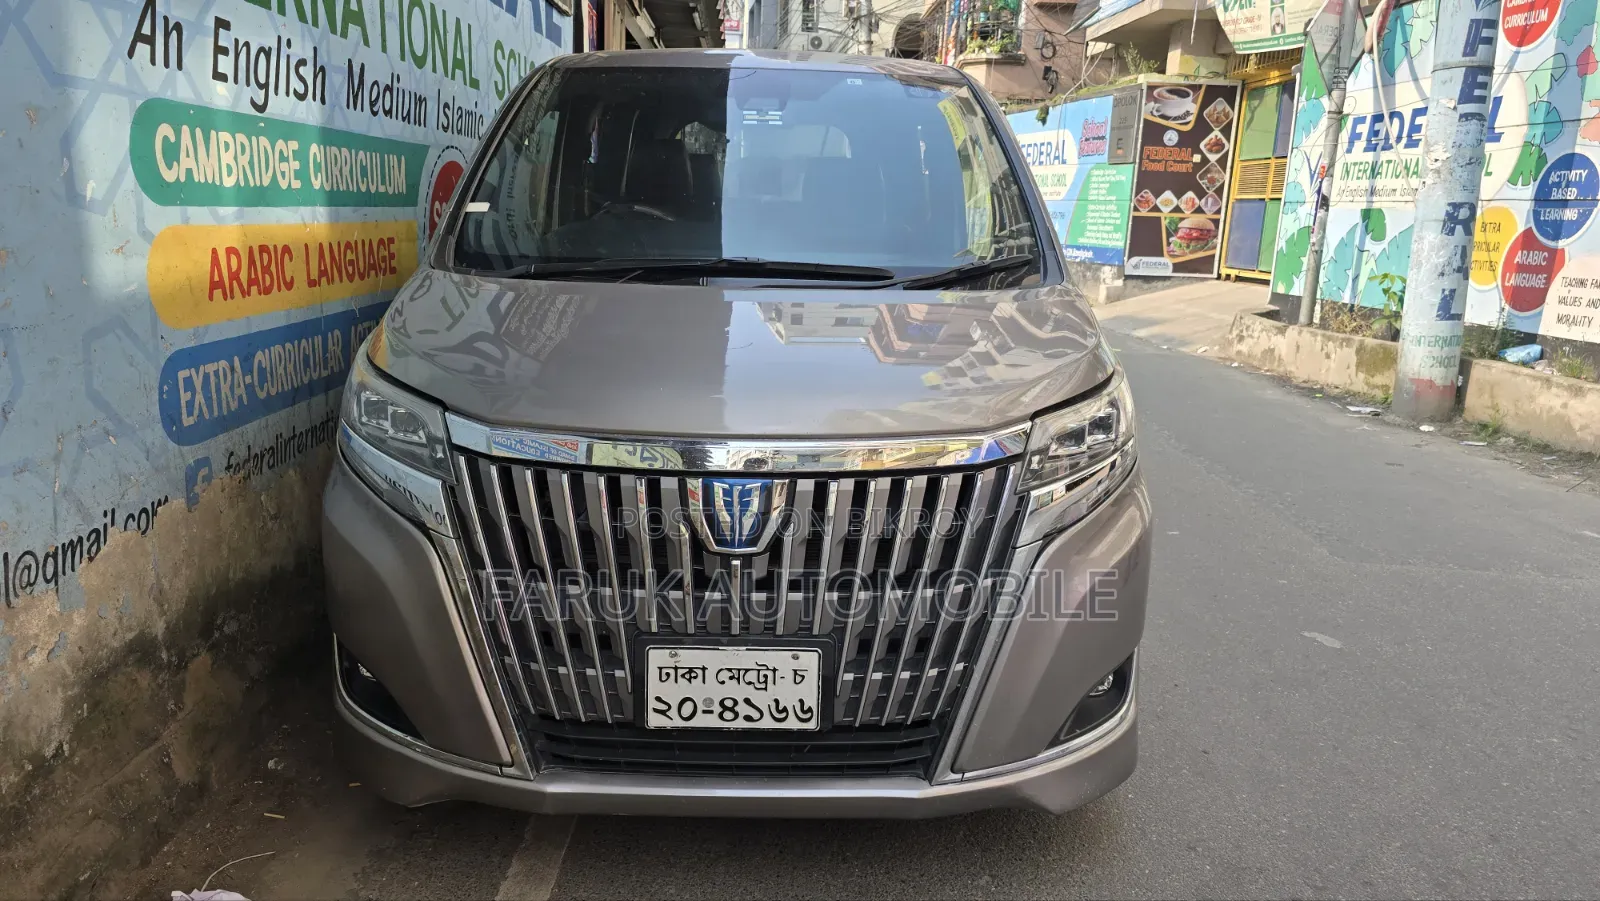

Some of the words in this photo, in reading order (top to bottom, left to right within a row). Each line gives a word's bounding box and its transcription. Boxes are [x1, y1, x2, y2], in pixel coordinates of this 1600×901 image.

[1504, 8, 1549, 29] CURRICULUM
[128, 0, 184, 71] An
[212, 17, 327, 114] English
[346, 58, 428, 129] Medium
[436, 89, 485, 141] Islamic
[154, 122, 301, 190] CAMBRIDGE
[309, 145, 407, 196] CURRICULUM
[1143, 146, 1193, 161] FEDERAL
[1142, 160, 1165, 171] Food
[1166, 160, 1193, 172] Court
[1339, 157, 1421, 181] INTERNATIONA
[1549, 169, 1588, 184] ACTIVITY
[1370, 184, 1397, 198] Medium
[1540, 208, 1578, 221] LEARNING
[1480, 221, 1501, 233] EXTRA
[1469, 259, 1498, 272] CTIVITIES
[1513, 250, 1549, 266] ARABIC
[206, 243, 295, 303] ARABIC
[304, 236, 398, 292] LANGUAGE
[1504, 272, 1548, 288] LANGUAGE
[1560, 276, 1589, 289] TEACHING
[1558, 295, 1583, 308] VALUES
[1585, 298, 1600, 310] AND
[1556, 313, 1594, 329] MORALITY
[177, 328, 345, 427] EXTRA-CURRICULAR
[224, 410, 339, 484] federalinternati
[657, 665, 709, 685] ঢাকা
[791, 668, 809, 685] চ
[652, 695, 814, 723] ২০-৪১৬৬
